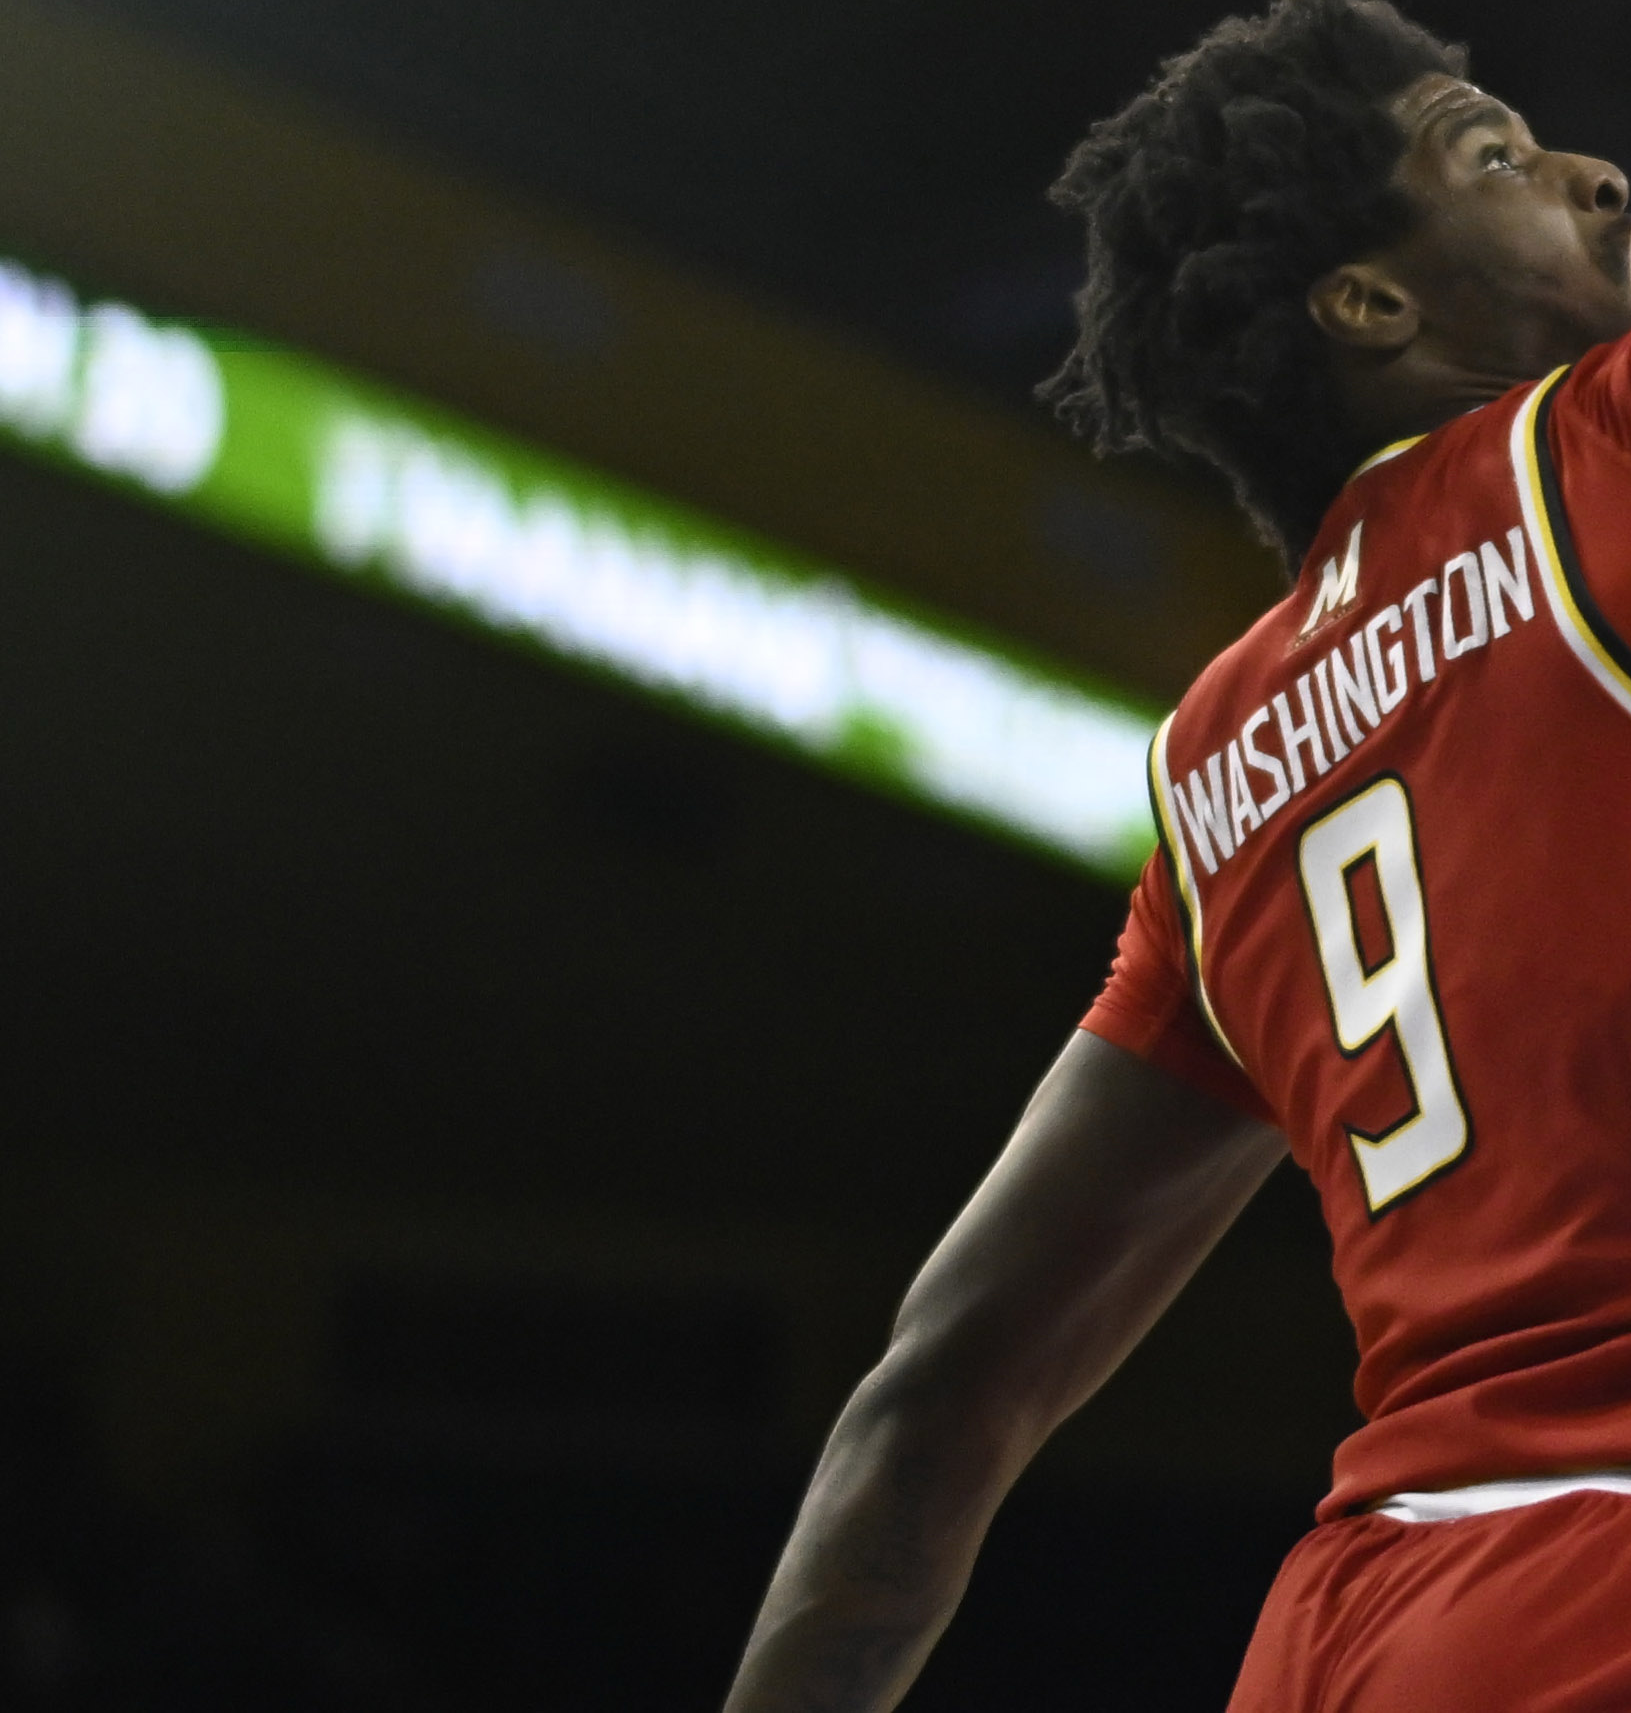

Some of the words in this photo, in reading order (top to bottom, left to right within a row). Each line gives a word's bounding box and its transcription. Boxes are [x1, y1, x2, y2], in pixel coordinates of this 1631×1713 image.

[1173, 525, 1535, 877] WASHINGTON
[1300, 519, 1364, 636] M
[1298, 770, 1472, 1221] 9
